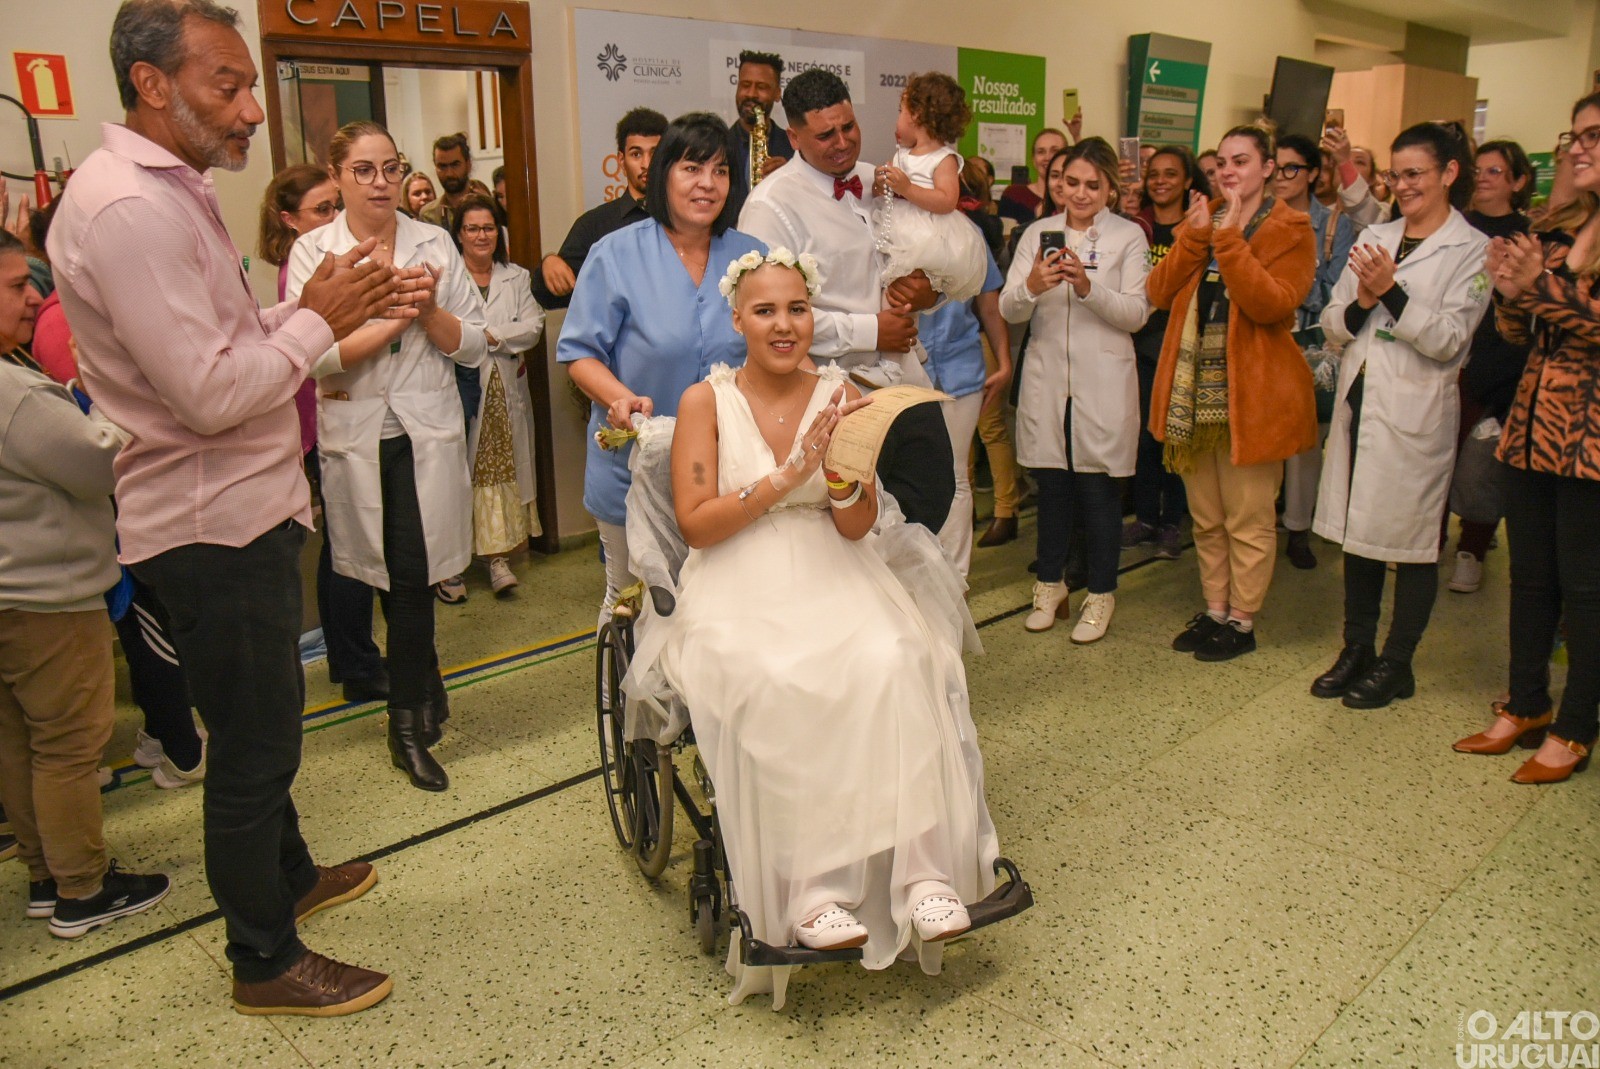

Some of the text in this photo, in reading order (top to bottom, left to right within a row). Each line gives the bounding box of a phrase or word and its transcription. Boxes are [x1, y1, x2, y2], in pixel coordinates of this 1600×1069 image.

[286, 0, 518, 39] CAPELA
[845, 65, 851, 76] E
[972, 75, 1019, 97] Nossos
[972, 95, 1037, 116] resultados
